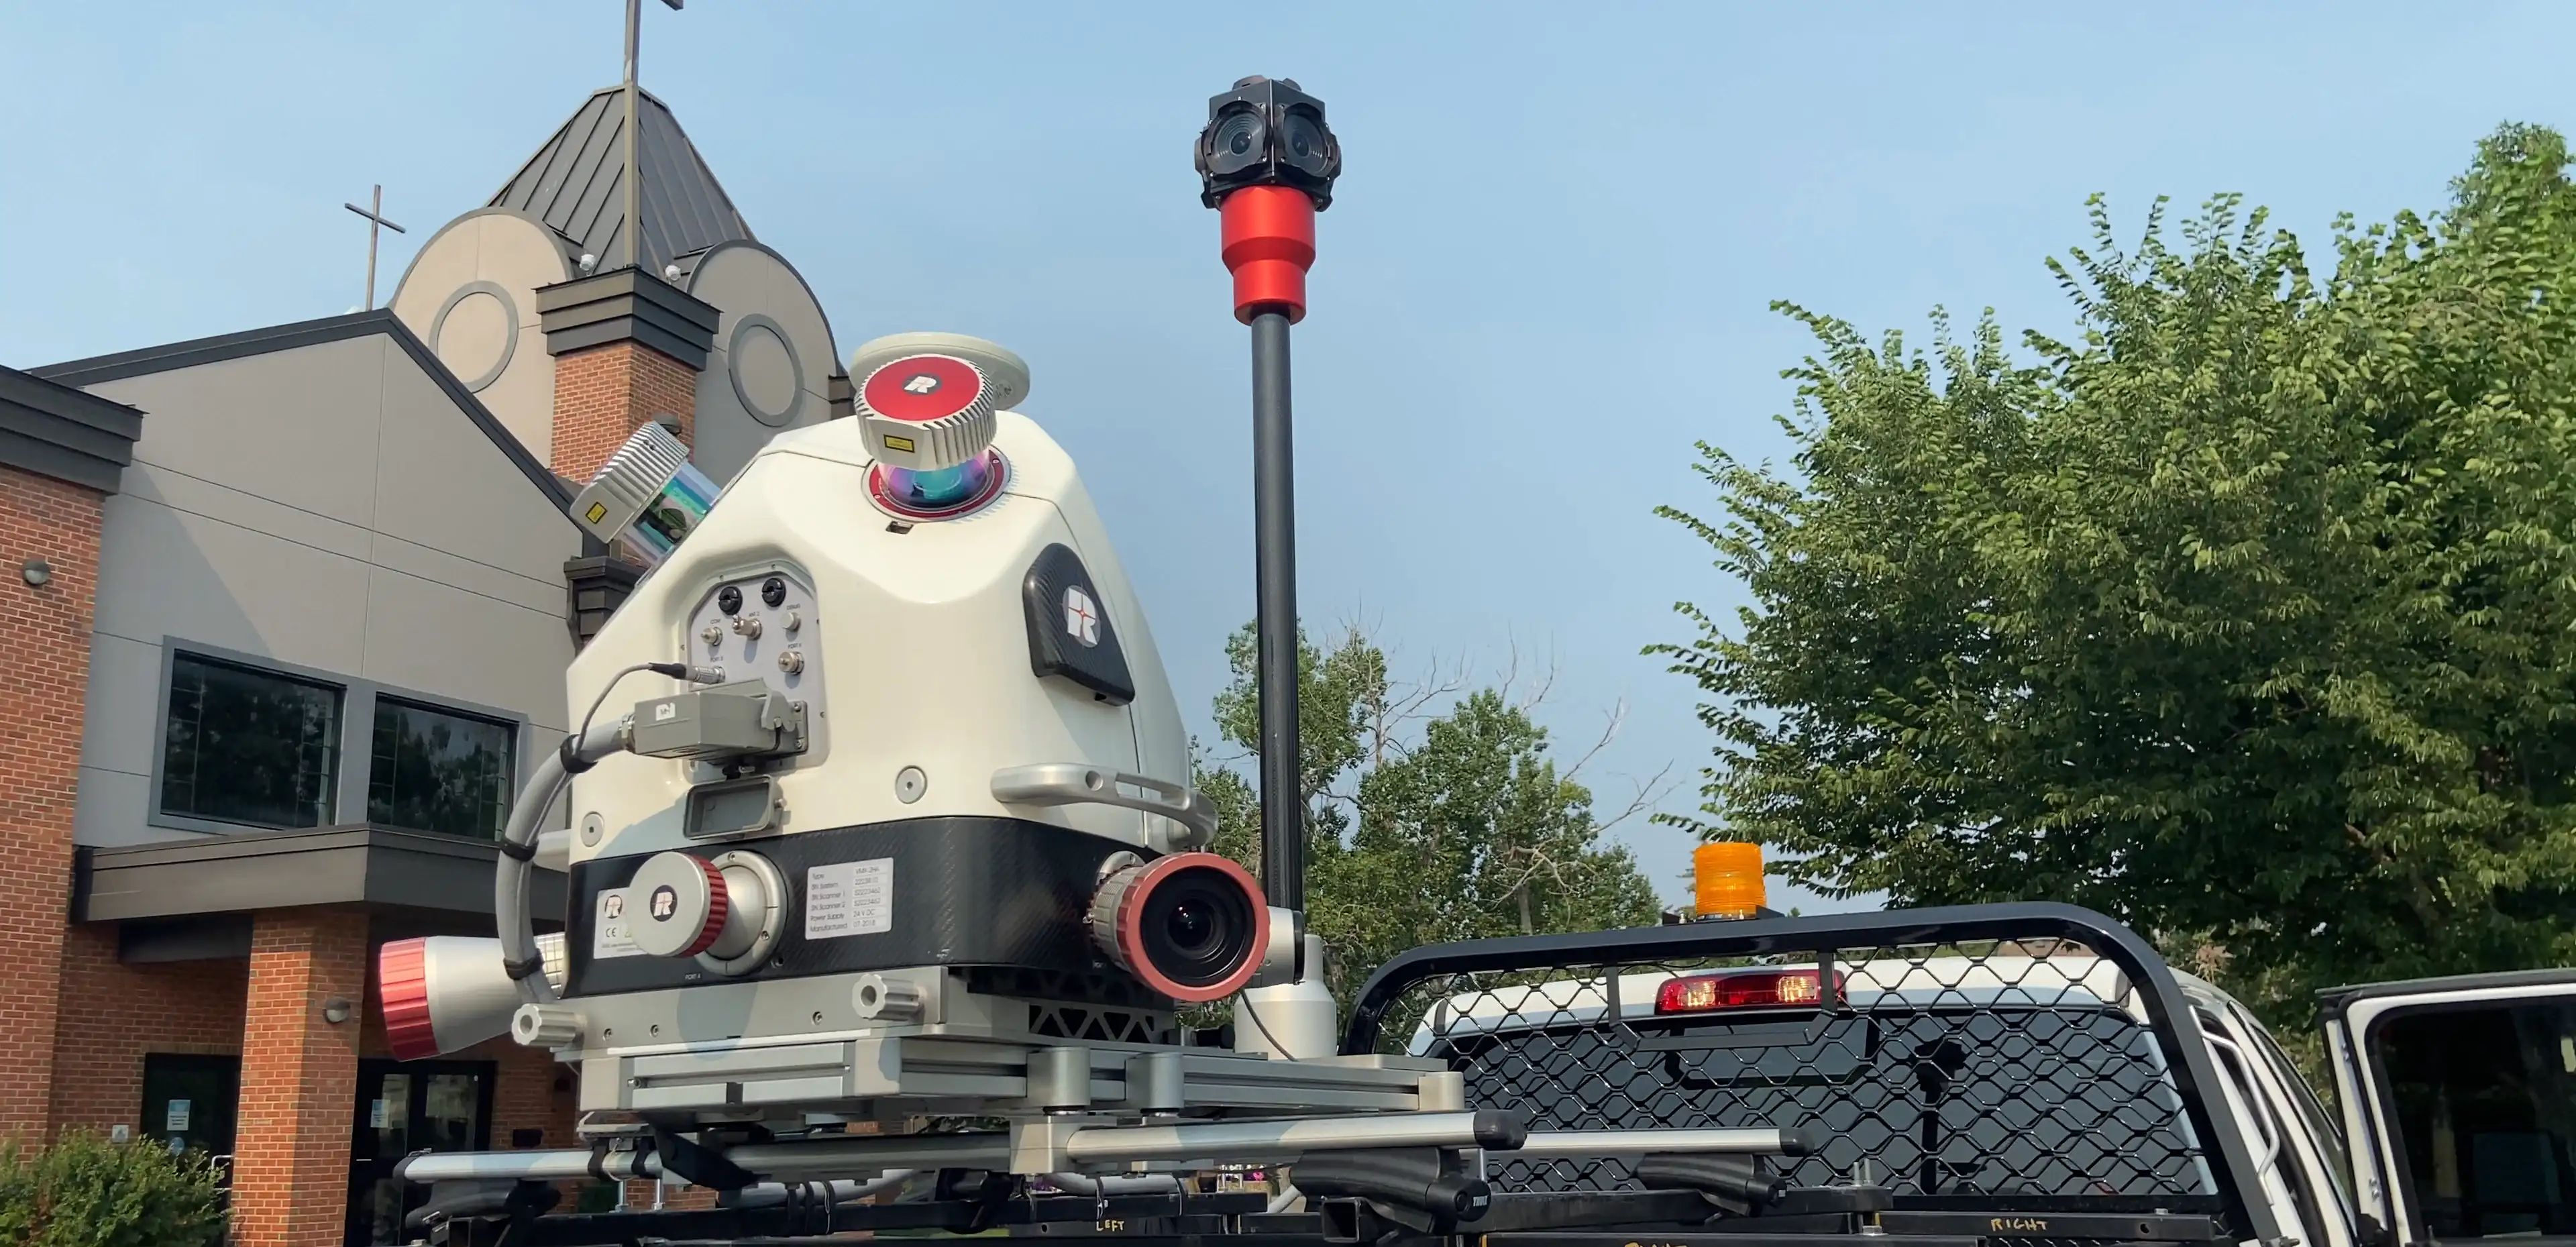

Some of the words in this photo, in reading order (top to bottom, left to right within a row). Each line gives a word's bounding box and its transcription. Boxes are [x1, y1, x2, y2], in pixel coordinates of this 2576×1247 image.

[810, 923, 848, 932] Manufactured
[1096, 1219, 1124, 1232] LEFT
[1990, 1217, 2047, 1232] RIGHT
